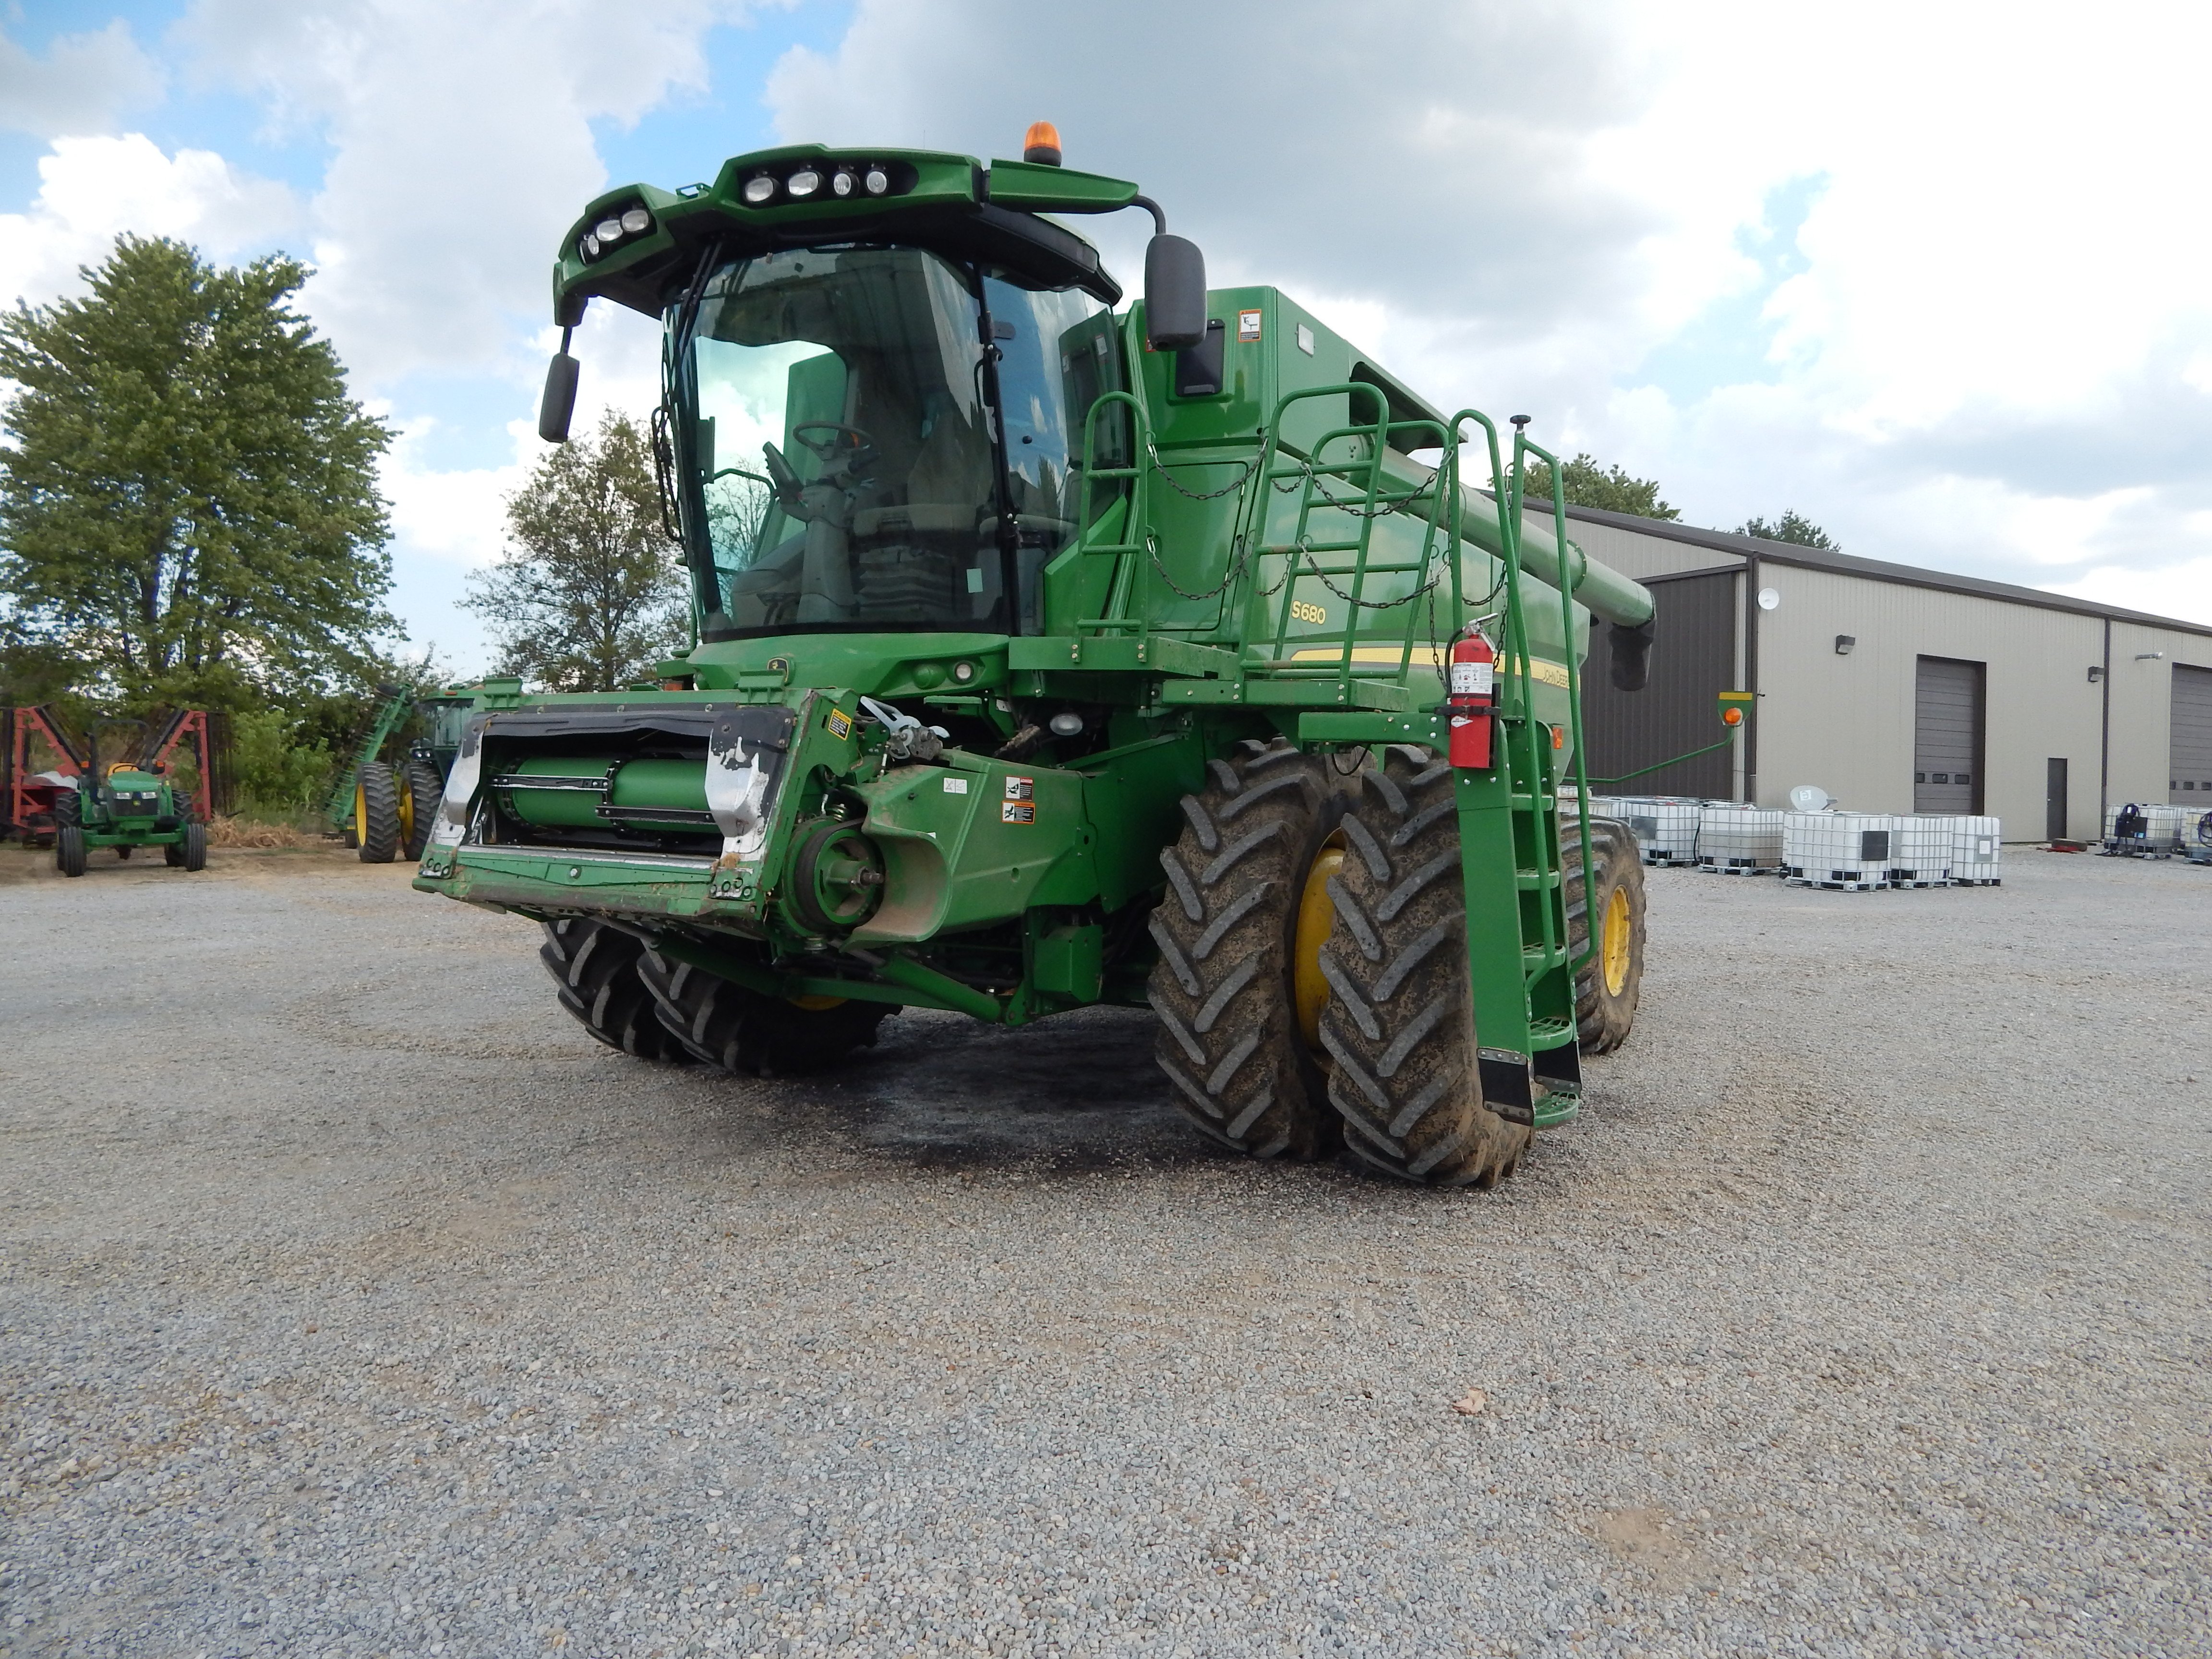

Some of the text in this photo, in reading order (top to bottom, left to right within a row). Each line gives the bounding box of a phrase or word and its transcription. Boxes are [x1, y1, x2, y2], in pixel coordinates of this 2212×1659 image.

[1292, 600, 1326, 625] S680
[1542, 666, 1568, 687] JOHN DEER
